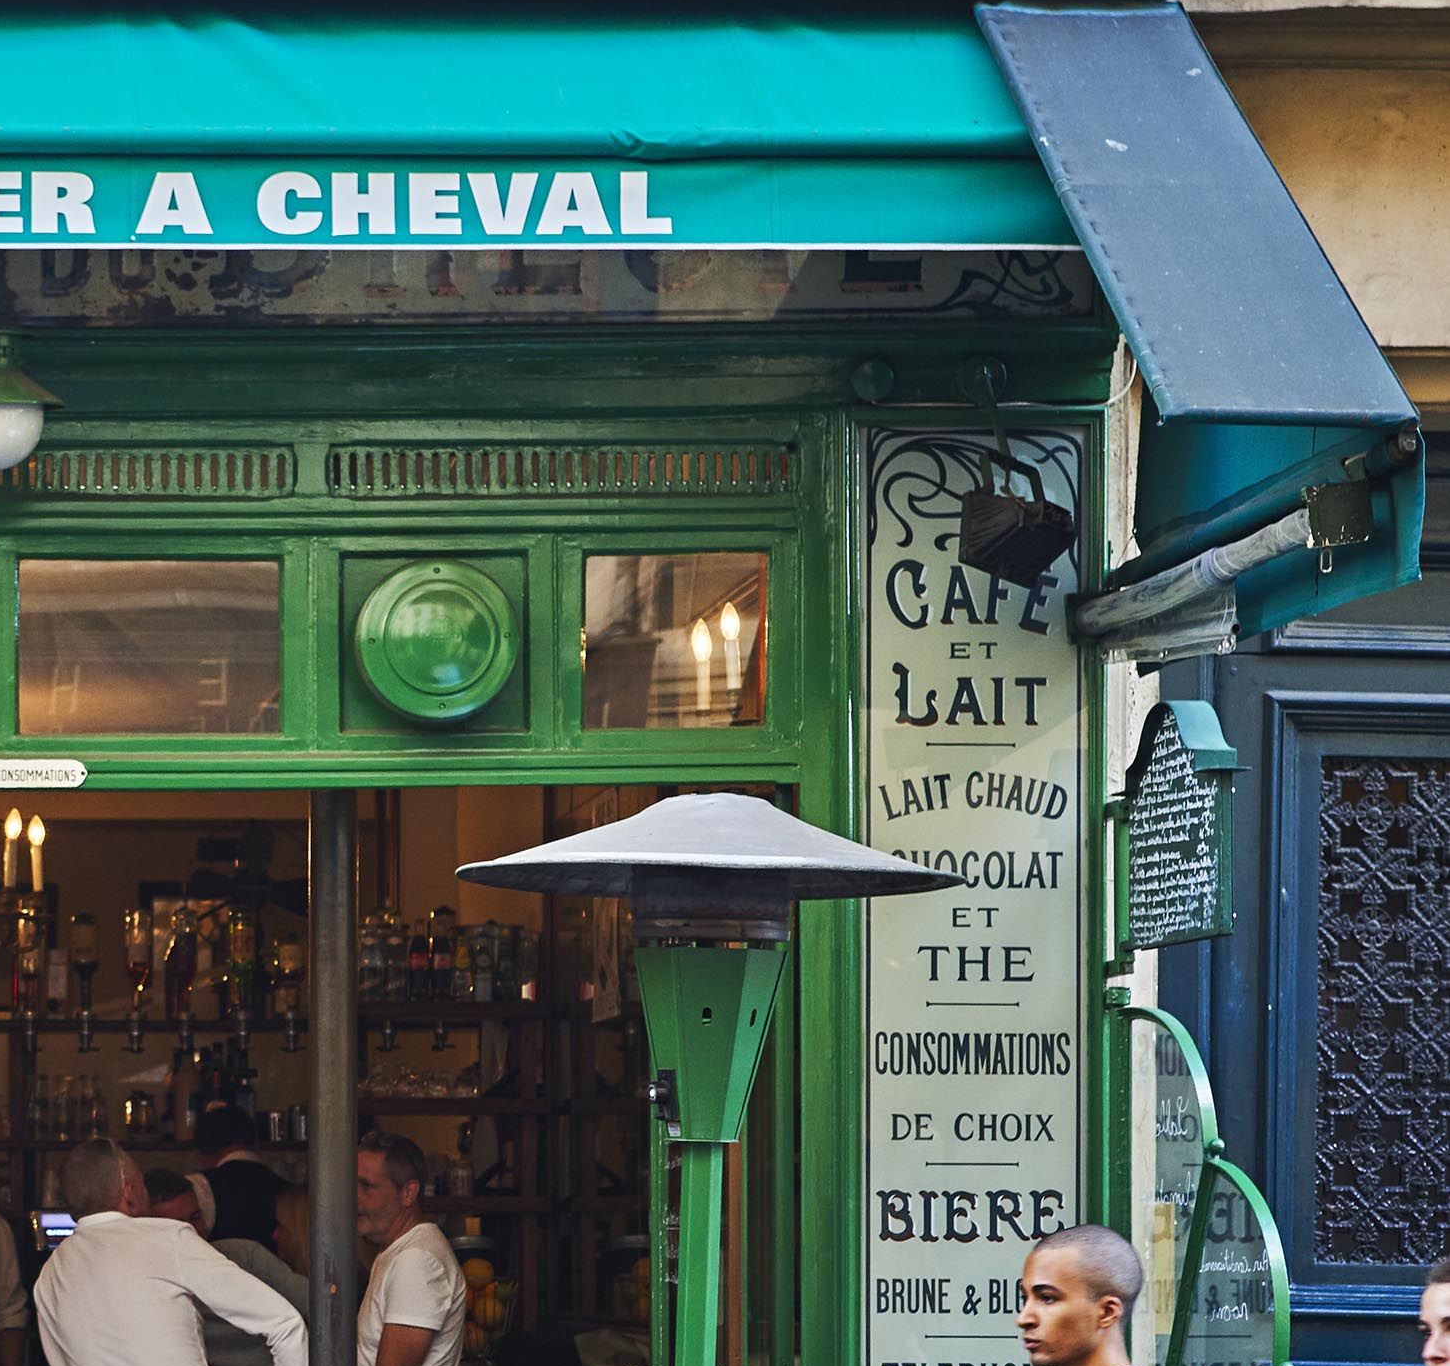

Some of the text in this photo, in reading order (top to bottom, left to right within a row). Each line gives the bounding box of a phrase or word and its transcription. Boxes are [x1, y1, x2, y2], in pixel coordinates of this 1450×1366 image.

[135, 172, 214, 235] A
[257, 172, 673, 236] CHEVAL
[949, 641, 999, 661] ET
[892, 662, 1048, 728] LAIT
[878, 770, 1068, 822] LAIT CHAUD
[952, 907, 1000, 928] ET
[917, 945, 1035, 982] THE
[875, 1031, 1071, 1076] CONSOMMATIONS
[891, 1112, 1055, 1142] DE CHOIX
[876, 1189, 1066, 1244] BIERE
[876, 1278, 951, 1314] BRUNE
[962, 1284, 982, 1316] &
